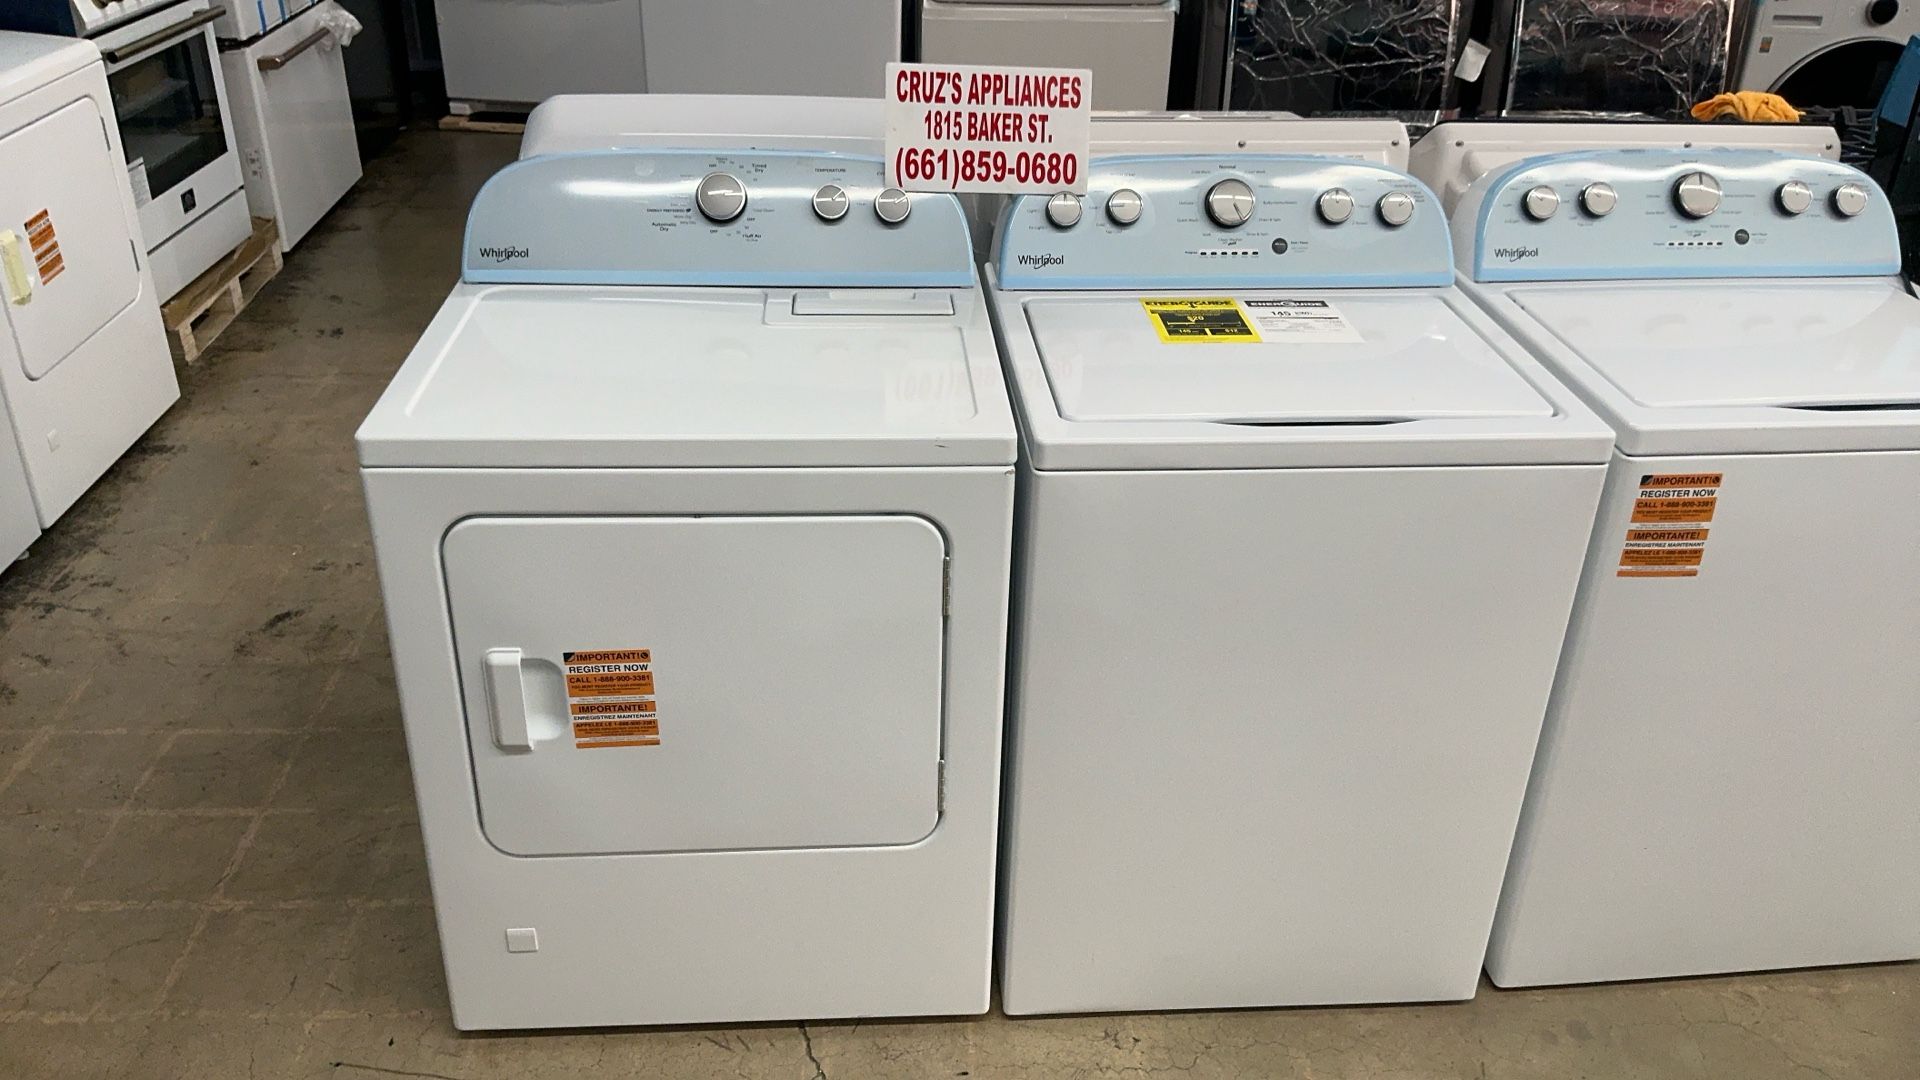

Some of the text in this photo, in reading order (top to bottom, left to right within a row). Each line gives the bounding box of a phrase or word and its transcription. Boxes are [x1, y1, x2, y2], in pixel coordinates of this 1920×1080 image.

[896, 70, 1081, 109] CRUZ'S APPLIANCES
[924, 110, 1053, 143] 1815 BAKER ST.
[896, 147, 1077, 189] (661)859-0680
[480, 247, 529, 263] Whirlpool
[1494, 247, 1539, 262] Whirlpool
[1017, 254, 1064, 269] Whirlpool
[1652, 476, 1712, 485] IMPORTANT!
[1640, 489, 1716, 498] REGISTER NOW
[1633, 532, 1700, 540] IMPORTANTE!
[576, 652, 640, 662] IMPORTANT!
[569, 664, 649, 674] REGISTER NOW
[569, 676, 591, 684] CALL
[578, 704, 648, 713] IMPORTANTE!
